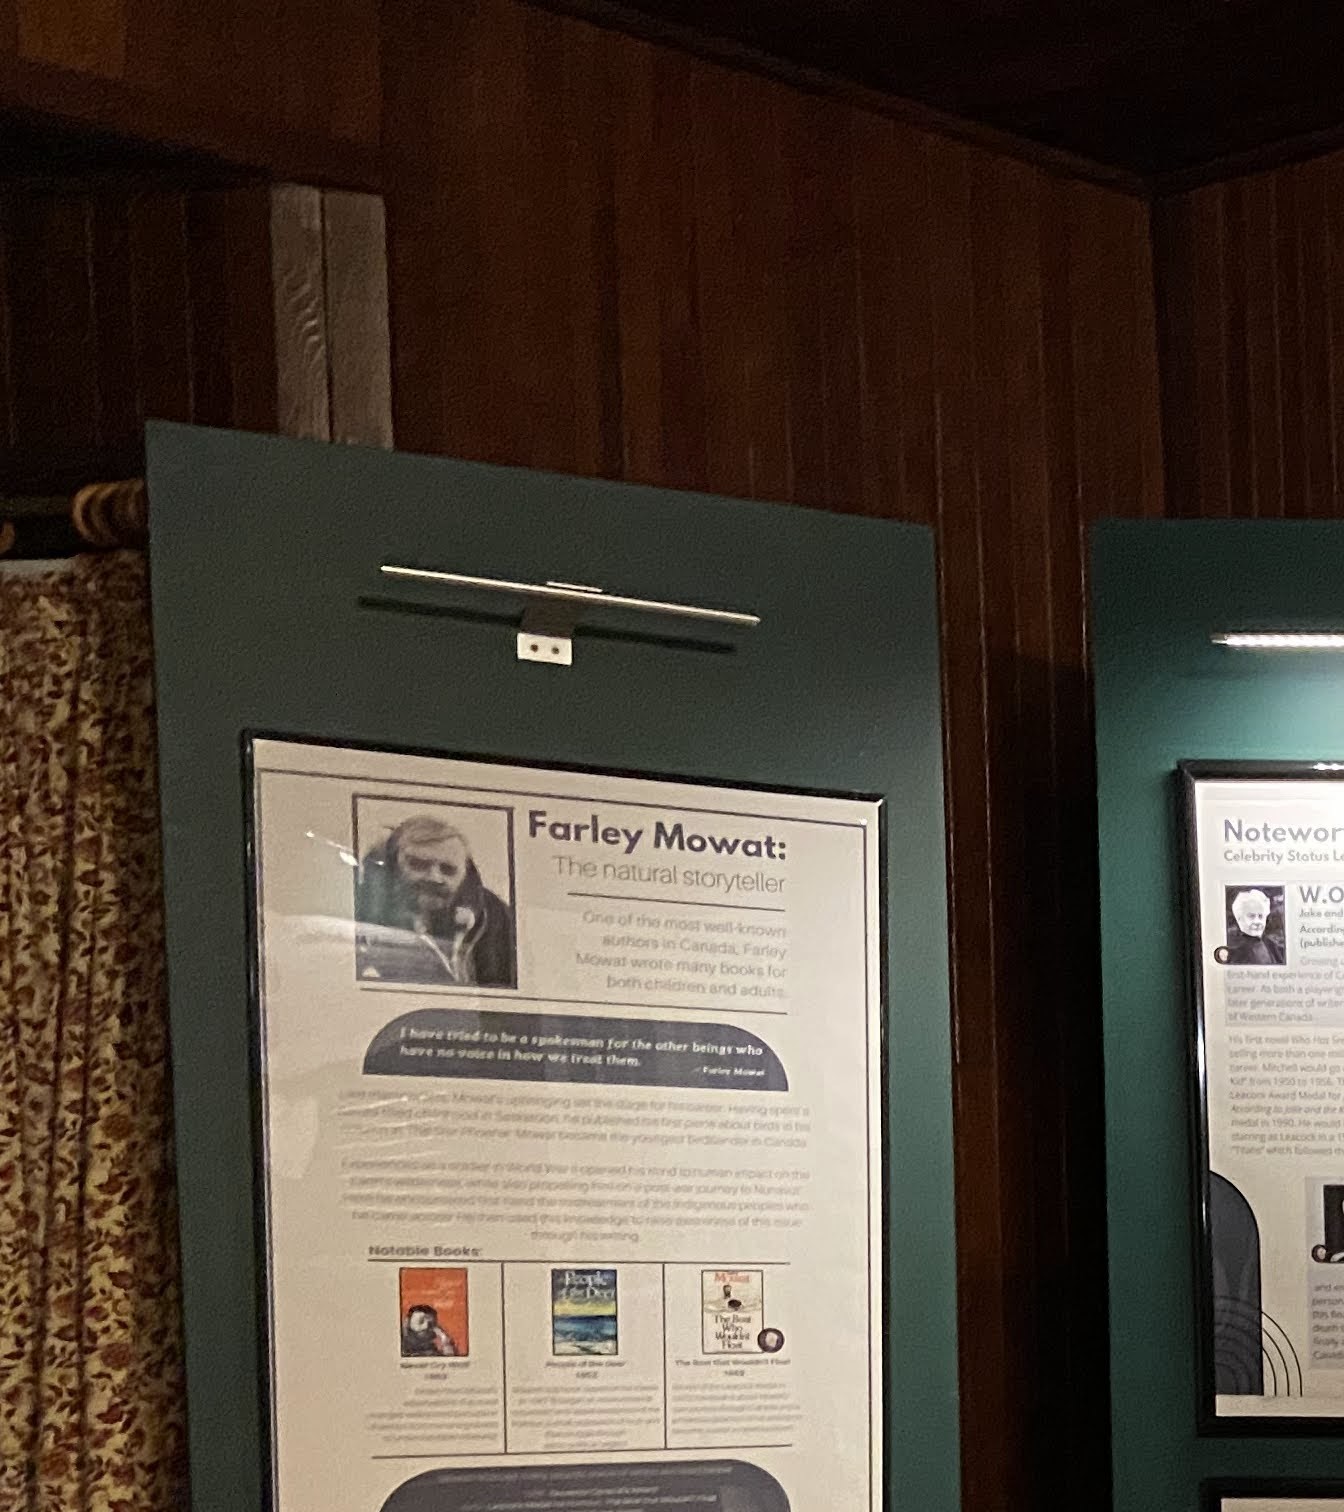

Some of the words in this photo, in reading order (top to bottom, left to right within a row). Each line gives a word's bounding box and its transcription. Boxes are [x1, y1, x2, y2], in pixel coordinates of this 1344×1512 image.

[529, 810, 644, 855] Farley
[653, 821, 788, 861] Mowat:
[553, 856, 598, 877] The
[603, 864, 677, 884] natural
[683, 870, 785, 893] storyteller
[1223, 849, 1283, 864] Celebrity
[1287, 850, 1329, 862] Status
